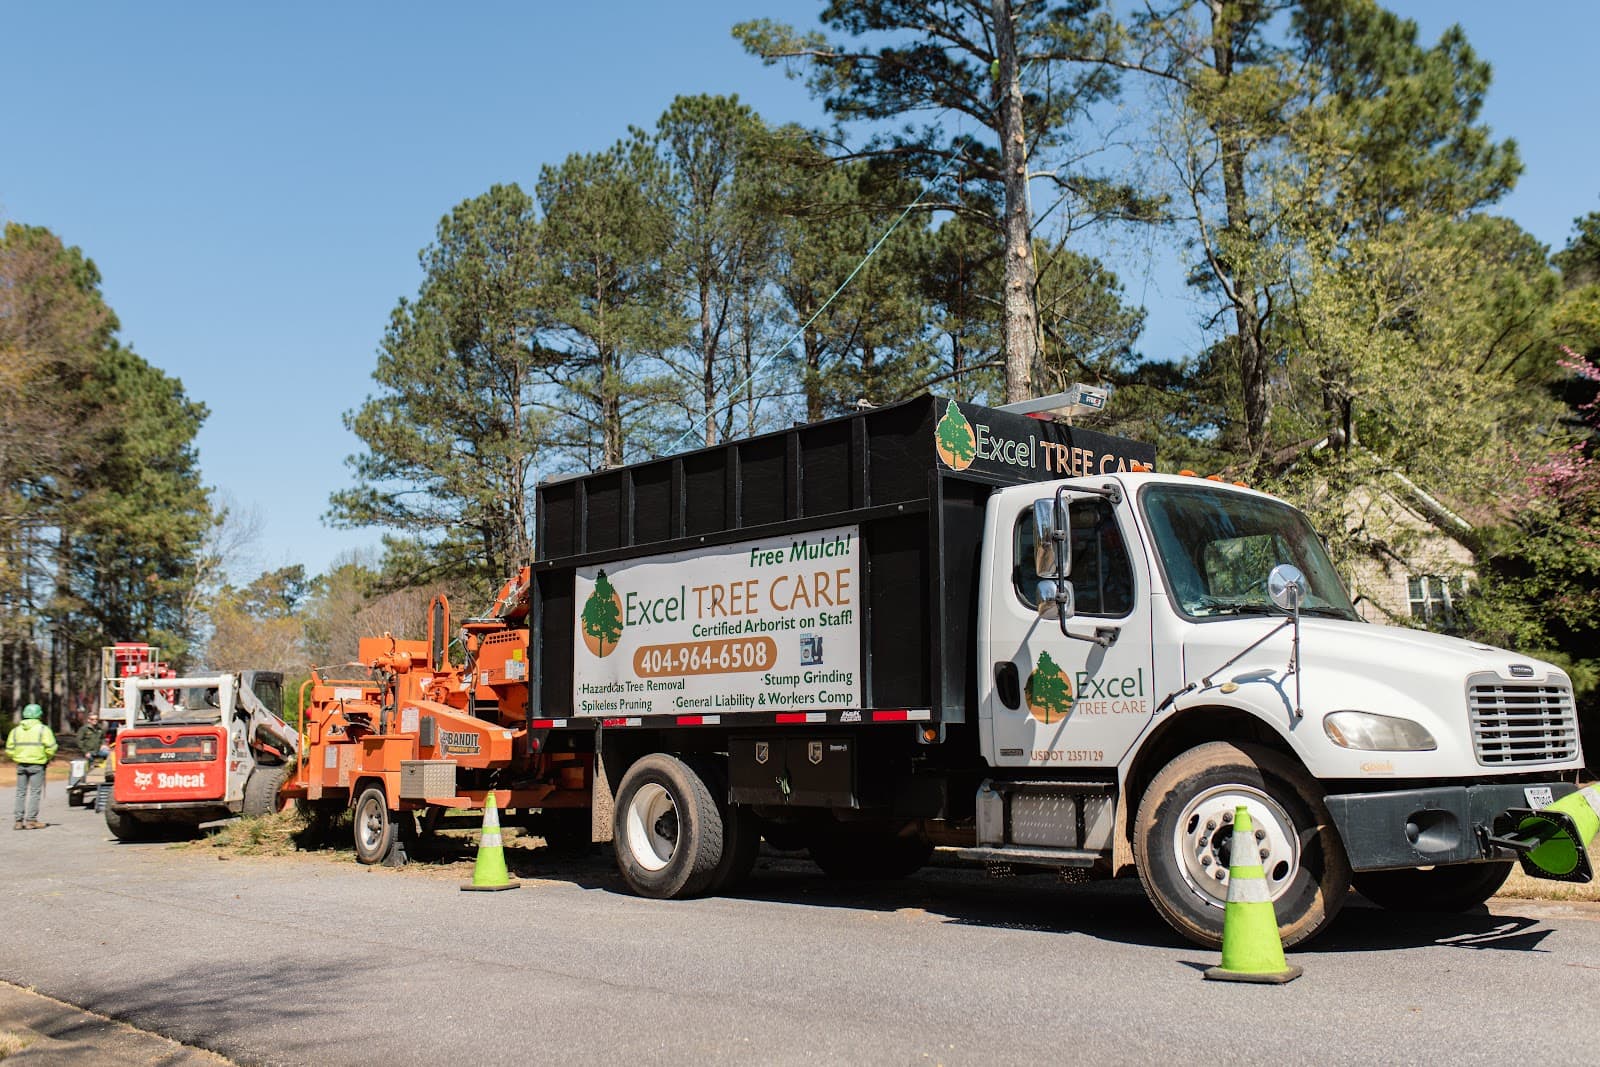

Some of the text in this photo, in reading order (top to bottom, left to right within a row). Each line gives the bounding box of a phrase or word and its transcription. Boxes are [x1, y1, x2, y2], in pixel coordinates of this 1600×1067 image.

[976, 424, 1153, 477] Excel TREE CA
[750, 534, 851, 568] Free Mulch!
[625, 568, 851, 627] Excel TREE CARE
[692, 610, 852, 638] Certified Arborist on Staff!
[641, 641, 768, 673] 404-964-6508
[625, 681, 644, 692] Tree
[646, 678, 685, 691] Removal
[764, 670, 853, 688] Stump Grinding
[1075, 667, 1144, 699] Excel
[581, 698, 652, 714] Spikeless Pruning
[676, 690, 853, 709] General Liability & Workers Comp
[1077, 700, 1147, 715] TREE CARE
[447, 732, 479, 746] BANDIT
[1031, 750, 1063, 761] USDOT
[1068, 750, 1104, 761] 2357129
[157, 772, 206, 789] Bobcat
